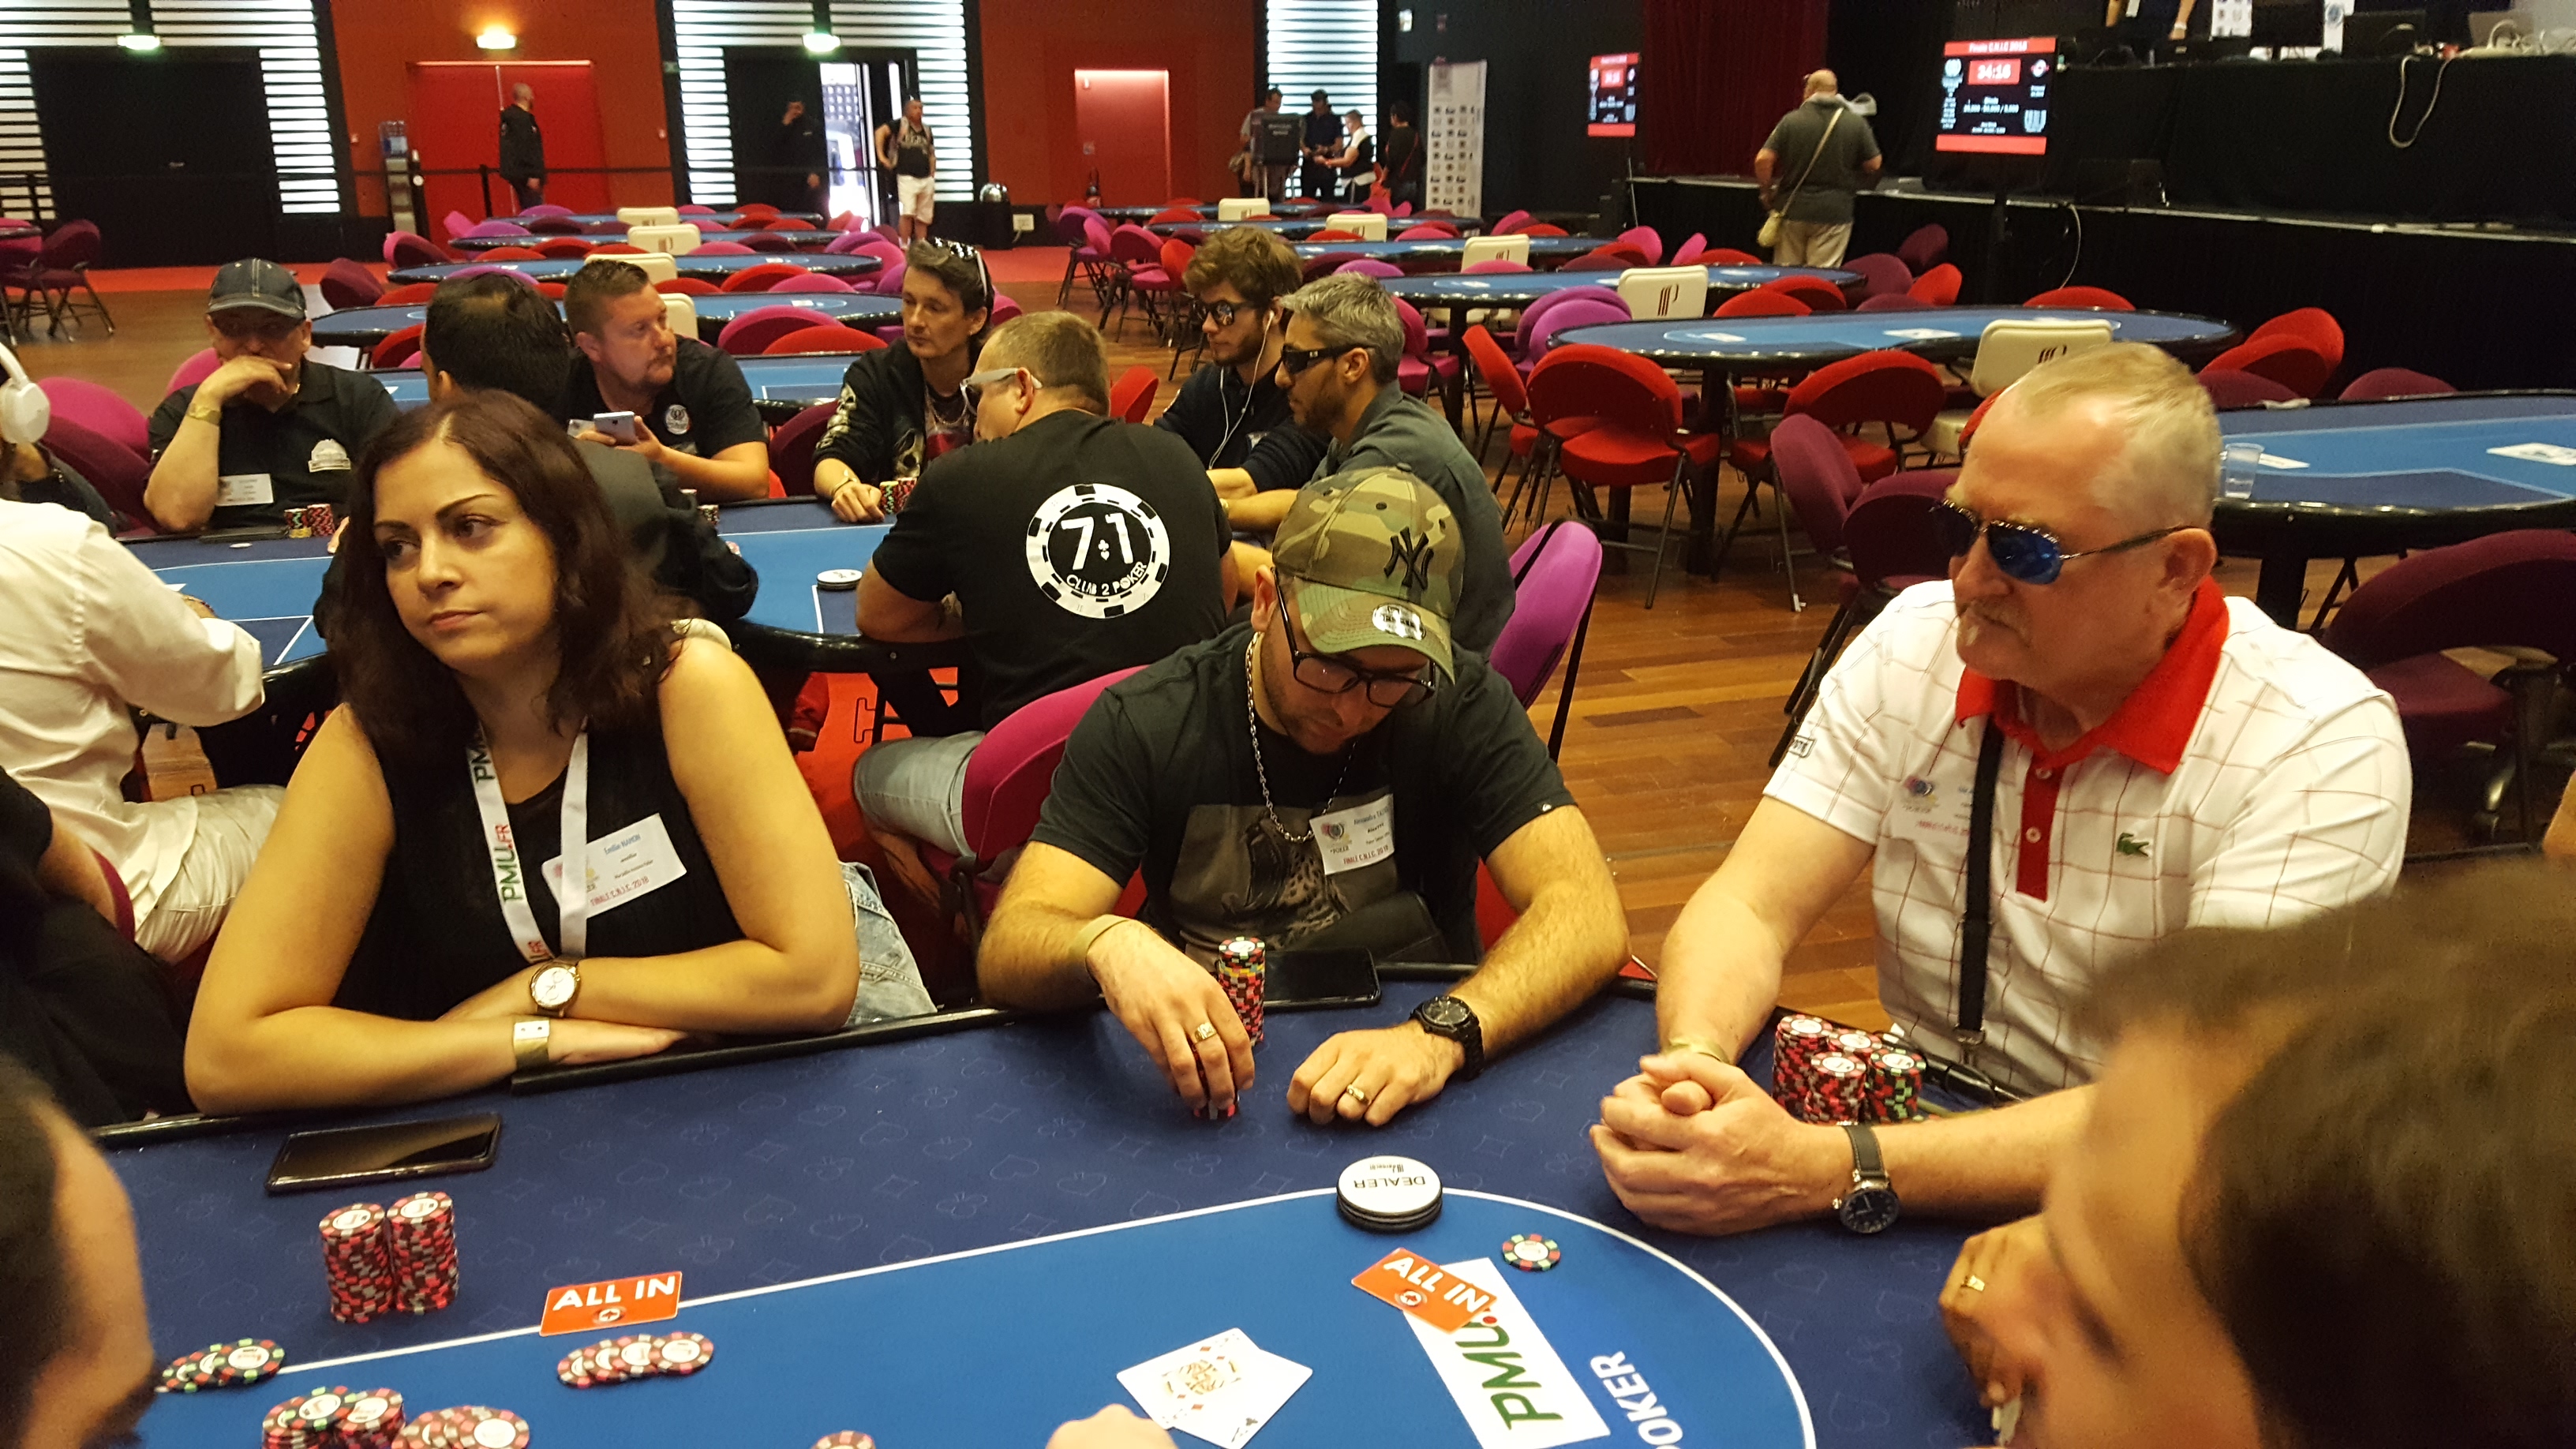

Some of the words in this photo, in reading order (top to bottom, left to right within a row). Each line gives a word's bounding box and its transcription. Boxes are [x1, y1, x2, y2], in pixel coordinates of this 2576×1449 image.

[1383, 526, 1435, 591] NY
[1066, 574, 1097, 594] CLUB
[1101, 583, 1110, 595] 2
[1112, 561, 1147, 593] POKER
[471, 747, 496, 784] PM
[1354, 1176, 1426, 1188] DEALER
[552, 1284, 622, 1311] ALL
[635, 1275, 676, 1300] IN
[1383, 1256, 1444, 1293] ALL
[1443, 1282, 1491, 1313] IN
[1589, 1350, 1684, 1449] OKER
